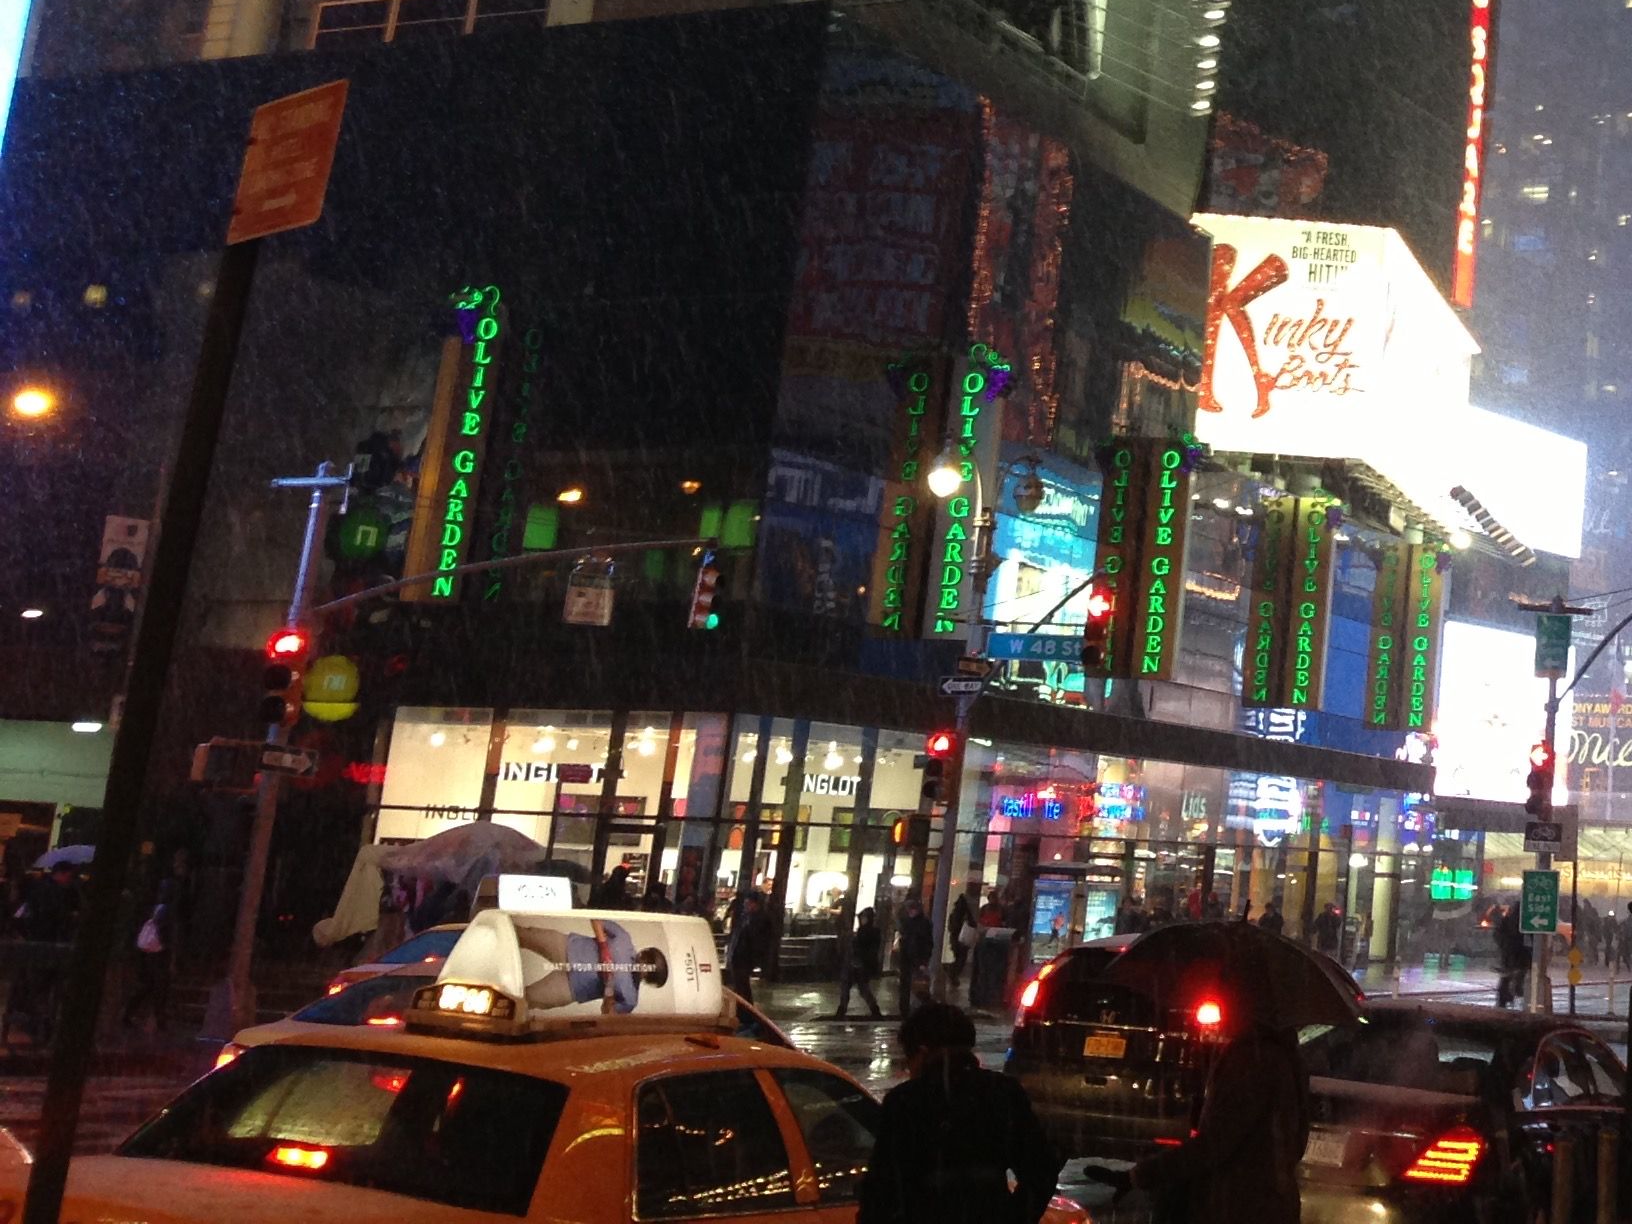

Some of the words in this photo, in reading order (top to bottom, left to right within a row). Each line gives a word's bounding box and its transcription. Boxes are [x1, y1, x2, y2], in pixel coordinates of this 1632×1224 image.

[1291, 245, 1357, 263] BIG-HEARTED
[1196, 242, 1354, 419] Kinky
[461, 317, 498, 436] OLIVE
[959, 373, 984, 482] OLIVE
[432, 450, 475, 597] GARDEN
[1156, 450, 1181, 545] OLIVE
[934, 496, 970, 633] GARDEN
[1304, 510, 1324, 592] OLIVE
[1416, 553, 1435, 627] OLIVE
[1010, 639, 1024, 654] W
[1030, 640, 1057, 655] 48
[1062, 641, 1081, 656] St
[1141, 558, 1170, 673] GARDEN
[1291, 602, 1316, 704] GARDEN
[1408, 636, 1429, 727] GARDEN
[1572, 703, 1590, 714] ONY
[499, 762, 606, 783] INGLT
[803, 773, 862, 796] NGLOT
[1527, 893, 1552, 903] East
[1527, 903, 1551, 913] Side
